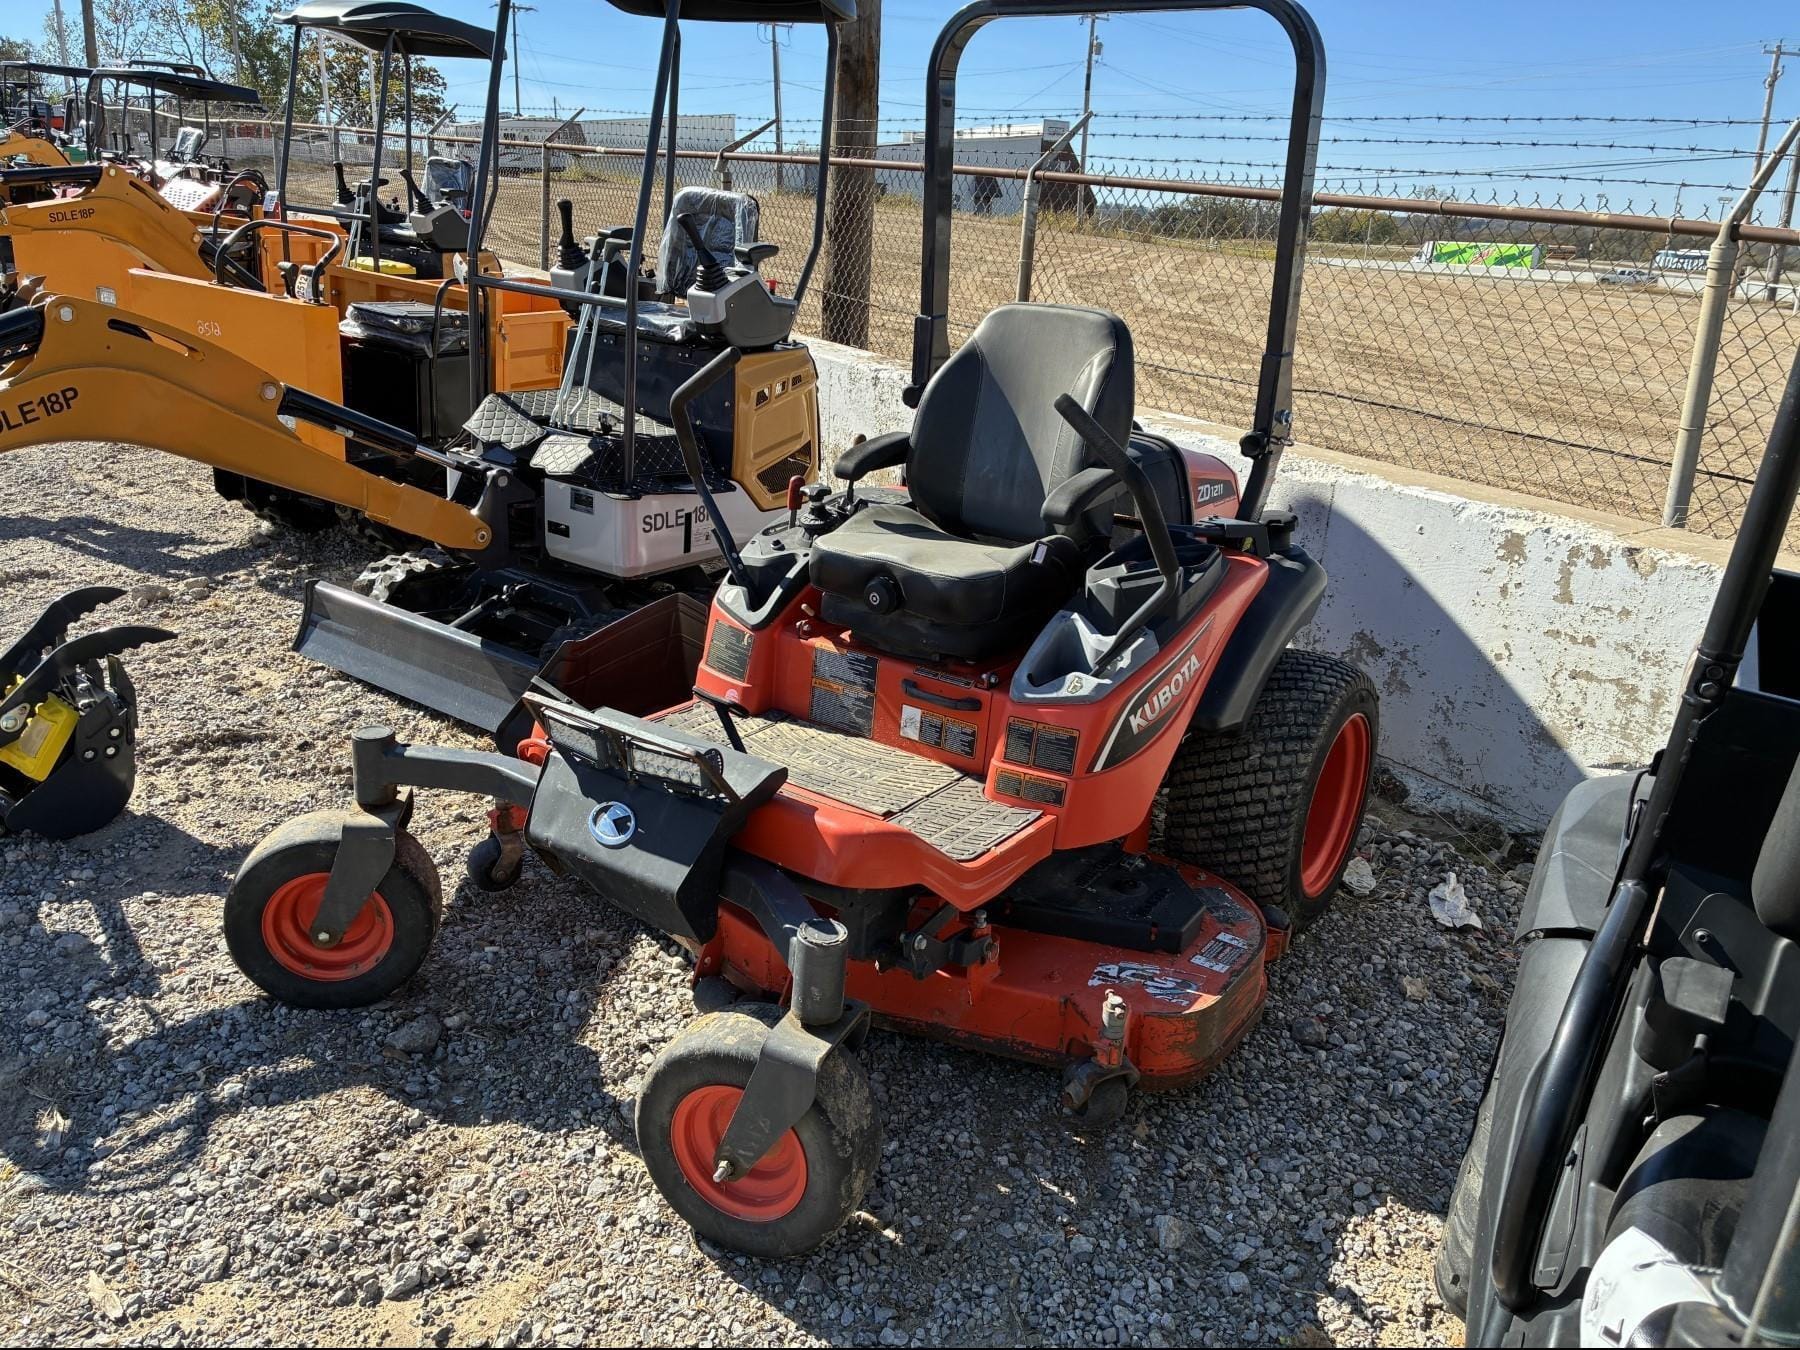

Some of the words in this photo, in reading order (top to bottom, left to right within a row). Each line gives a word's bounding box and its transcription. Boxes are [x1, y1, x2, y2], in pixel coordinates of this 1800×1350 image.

[48, 208, 96, 223] SDLE18P
[197, 319, 222, 336] 2512
[0, 386, 79, 434] LE18P
[1197, 483, 1224, 503] ZD1211
[642, 508, 685, 533] SDLE
[1128, 654, 1201, 736] KUBOTA
